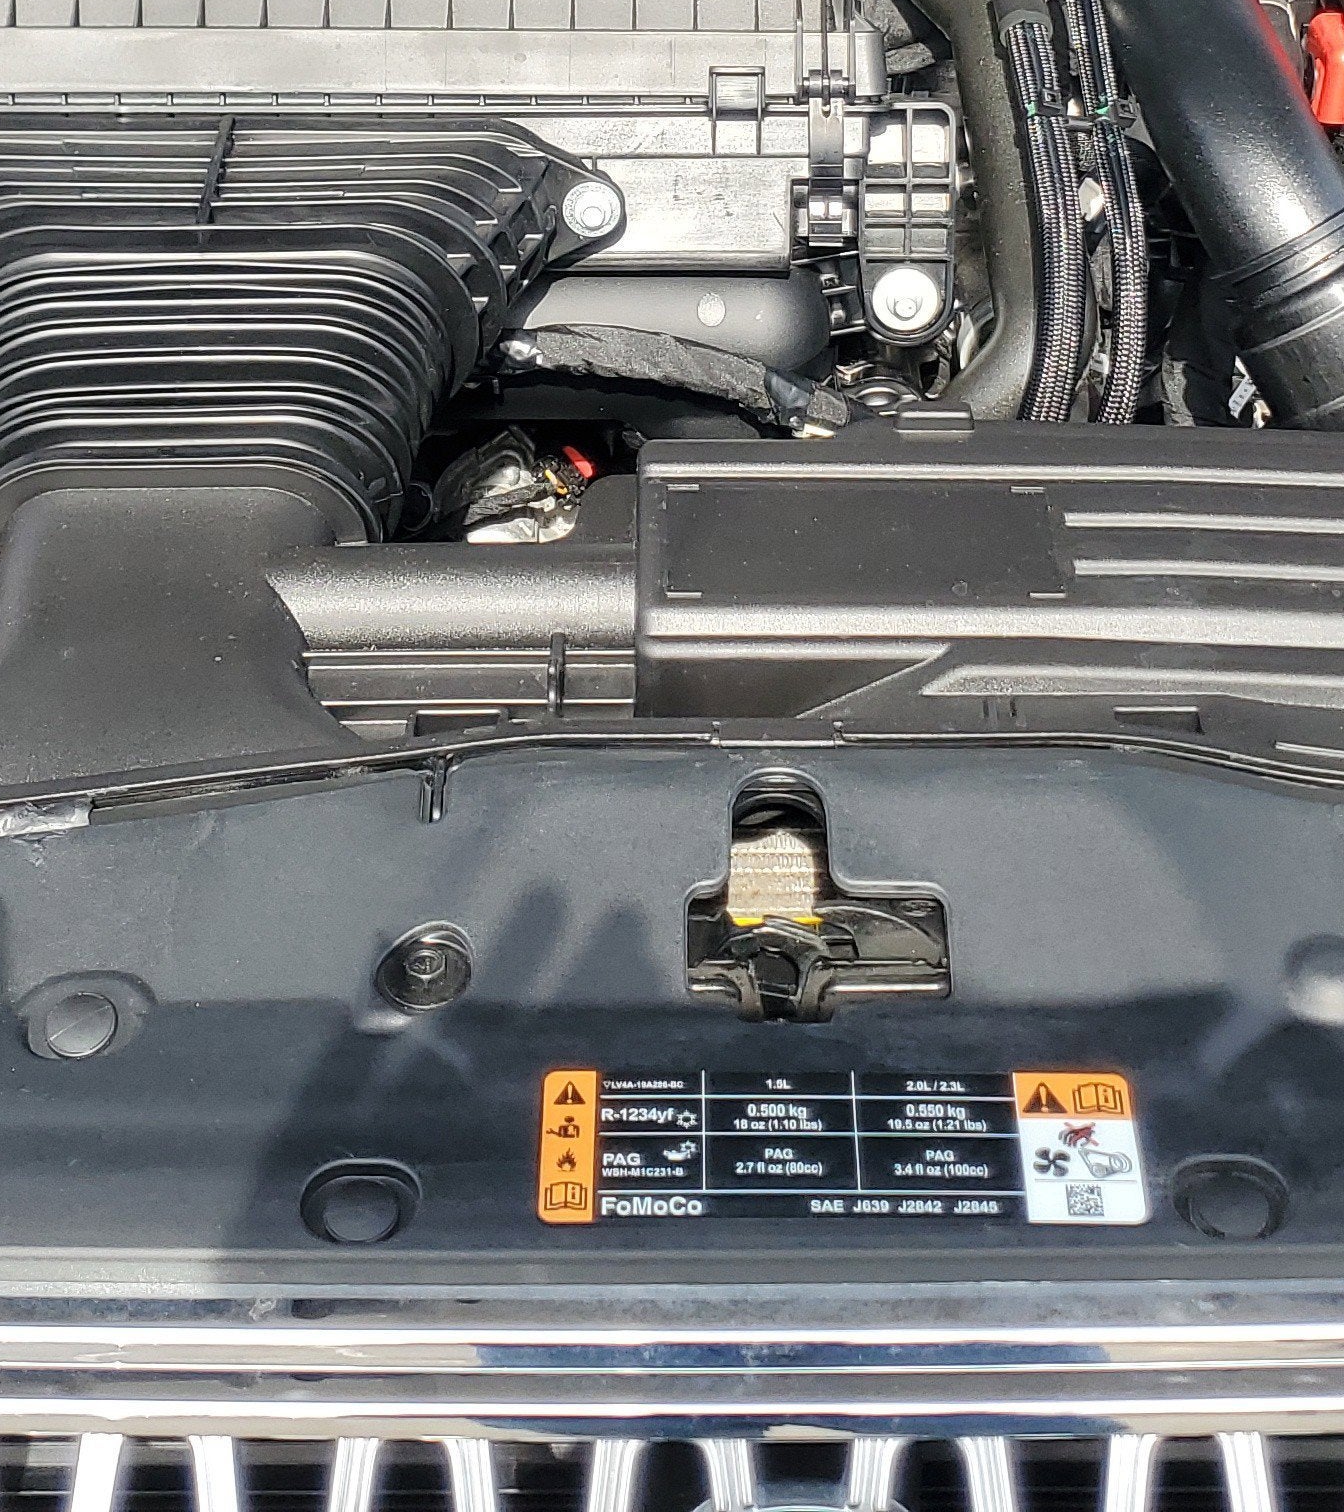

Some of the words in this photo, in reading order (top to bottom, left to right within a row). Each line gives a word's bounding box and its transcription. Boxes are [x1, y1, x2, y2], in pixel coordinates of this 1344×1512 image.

[906, 1080, 932, 1091] 2.0L
[940, 1080, 965, 1091] 2.3L
[601, 1108, 674, 1123] R-1234yf
[747, 1103, 787, 1117] 0.500
[789, 1103, 807, 1119] kg
[906, 1103, 944, 1118] 0.550
[947, 1103, 965, 1120] kg
[734, 1119, 748, 1130] 18
[751, 1121, 765, 1130] oz
[768, 1119, 797, 1131] (1.10
[800, 1119, 823, 1131] lbs)
[915, 1121, 930, 1131] oz
[933, 1118, 960, 1132] (1.21
[964, 1118, 987, 1132] lbs)
[602, 1153, 642, 1166] PAG
[765, 1148, 794, 1159] PAG
[925, 1150, 955, 1161] PAG
[735, 1161, 753, 1174] 2.7
[757, 1161, 765, 1174] fl
[768, 1164, 783, 1174] oz
[785, 1161, 823, 1176] (80cc)
[894, 1163, 913, 1176] 3.4
[915, 1163, 924, 1175] fl
[927, 1166, 942, 1176] oz
[944, 1163, 989, 1178] (100cc)
[601, 1195, 703, 1216] FoMoCo
[810, 1199, 845, 1212] SAE
[853, 1199, 890, 1213] J639
[897, 1199, 943, 1213] J2842
